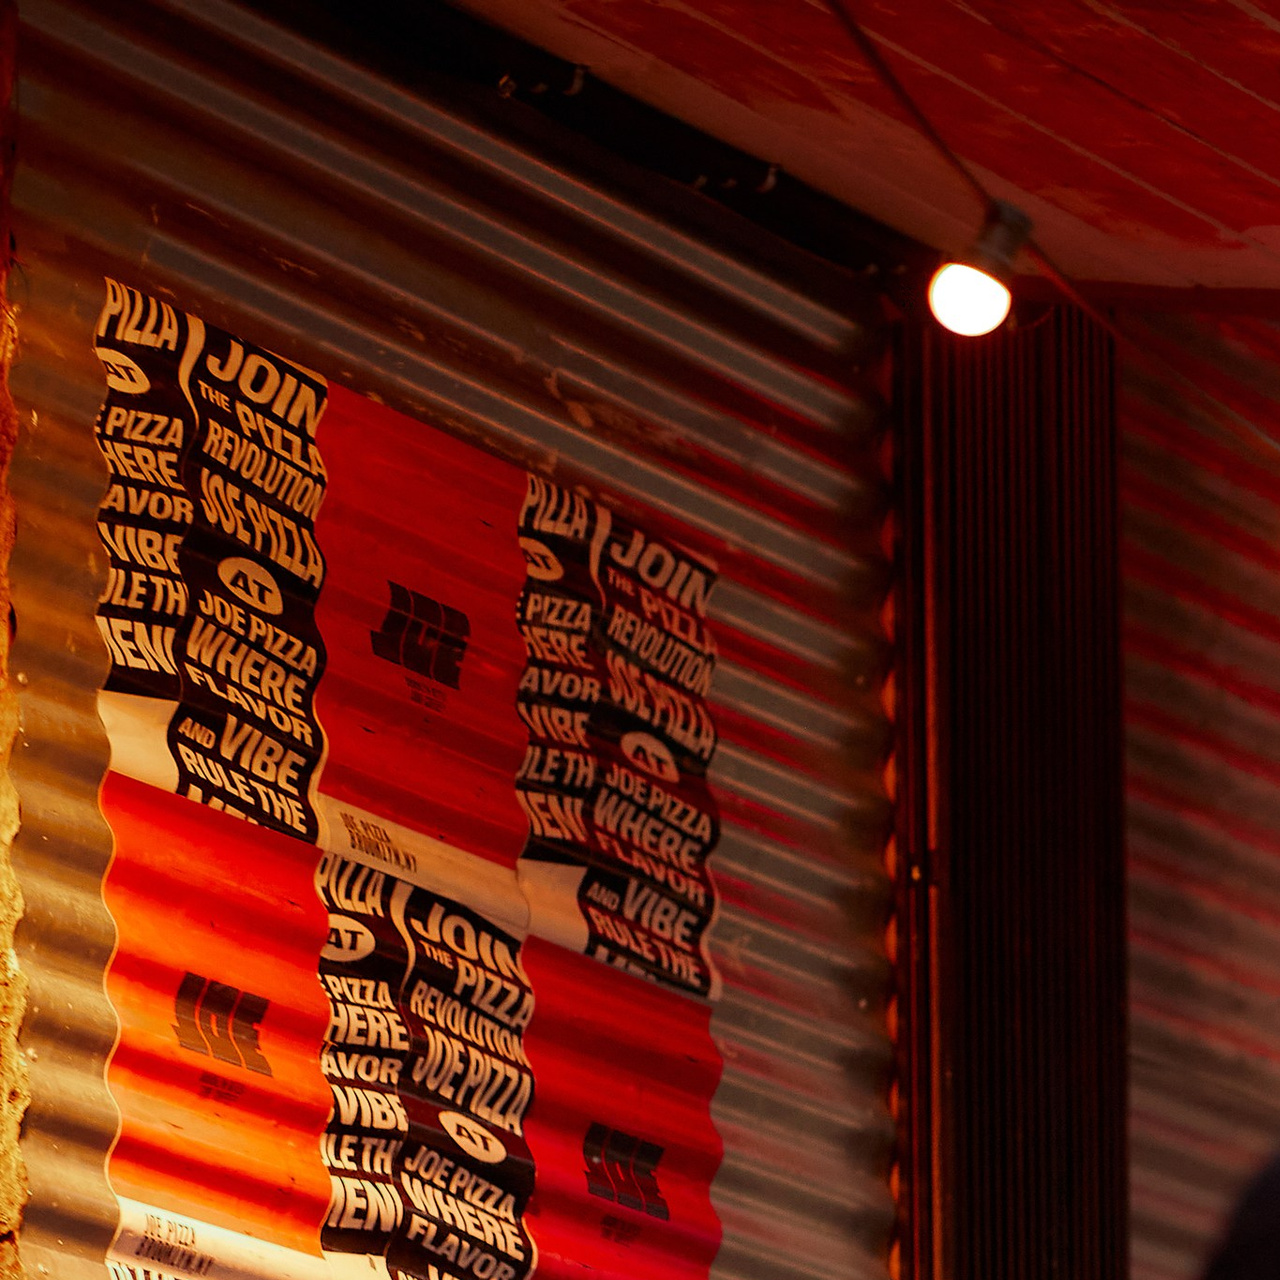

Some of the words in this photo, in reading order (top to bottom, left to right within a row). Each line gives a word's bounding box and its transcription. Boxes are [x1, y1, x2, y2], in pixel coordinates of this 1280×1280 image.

[198, 380, 232, 412] THE
[235, 400, 327, 482] PIZZA
[206, 339, 328, 438] JOIN
[202, 418, 325, 522] REVOLUTION
[187, 615, 306, 717] WHERE
[199, 589, 245, 635] JOE
[248, 614, 317, 678] PIZZA
[184, 662, 313, 747] FLAVOR
[177, 743, 256, 805] RULE
[248, 778, 307, 834] THE
[178, 717, 216, 749] AND
[220, 713, 306, 796] VIBE
[411, 903, 533, 994] JOIN
[419, 940, 453, 970] THE
[453, 957, 535, 1030] PIZZA
[410, 979, 532, 1069] REVOLUTION
[400, 1171, 525, 1262] WHERE
[405, 1145, 454, 1190] JOE
[450, 1166, 516, 1225] PIZZA
